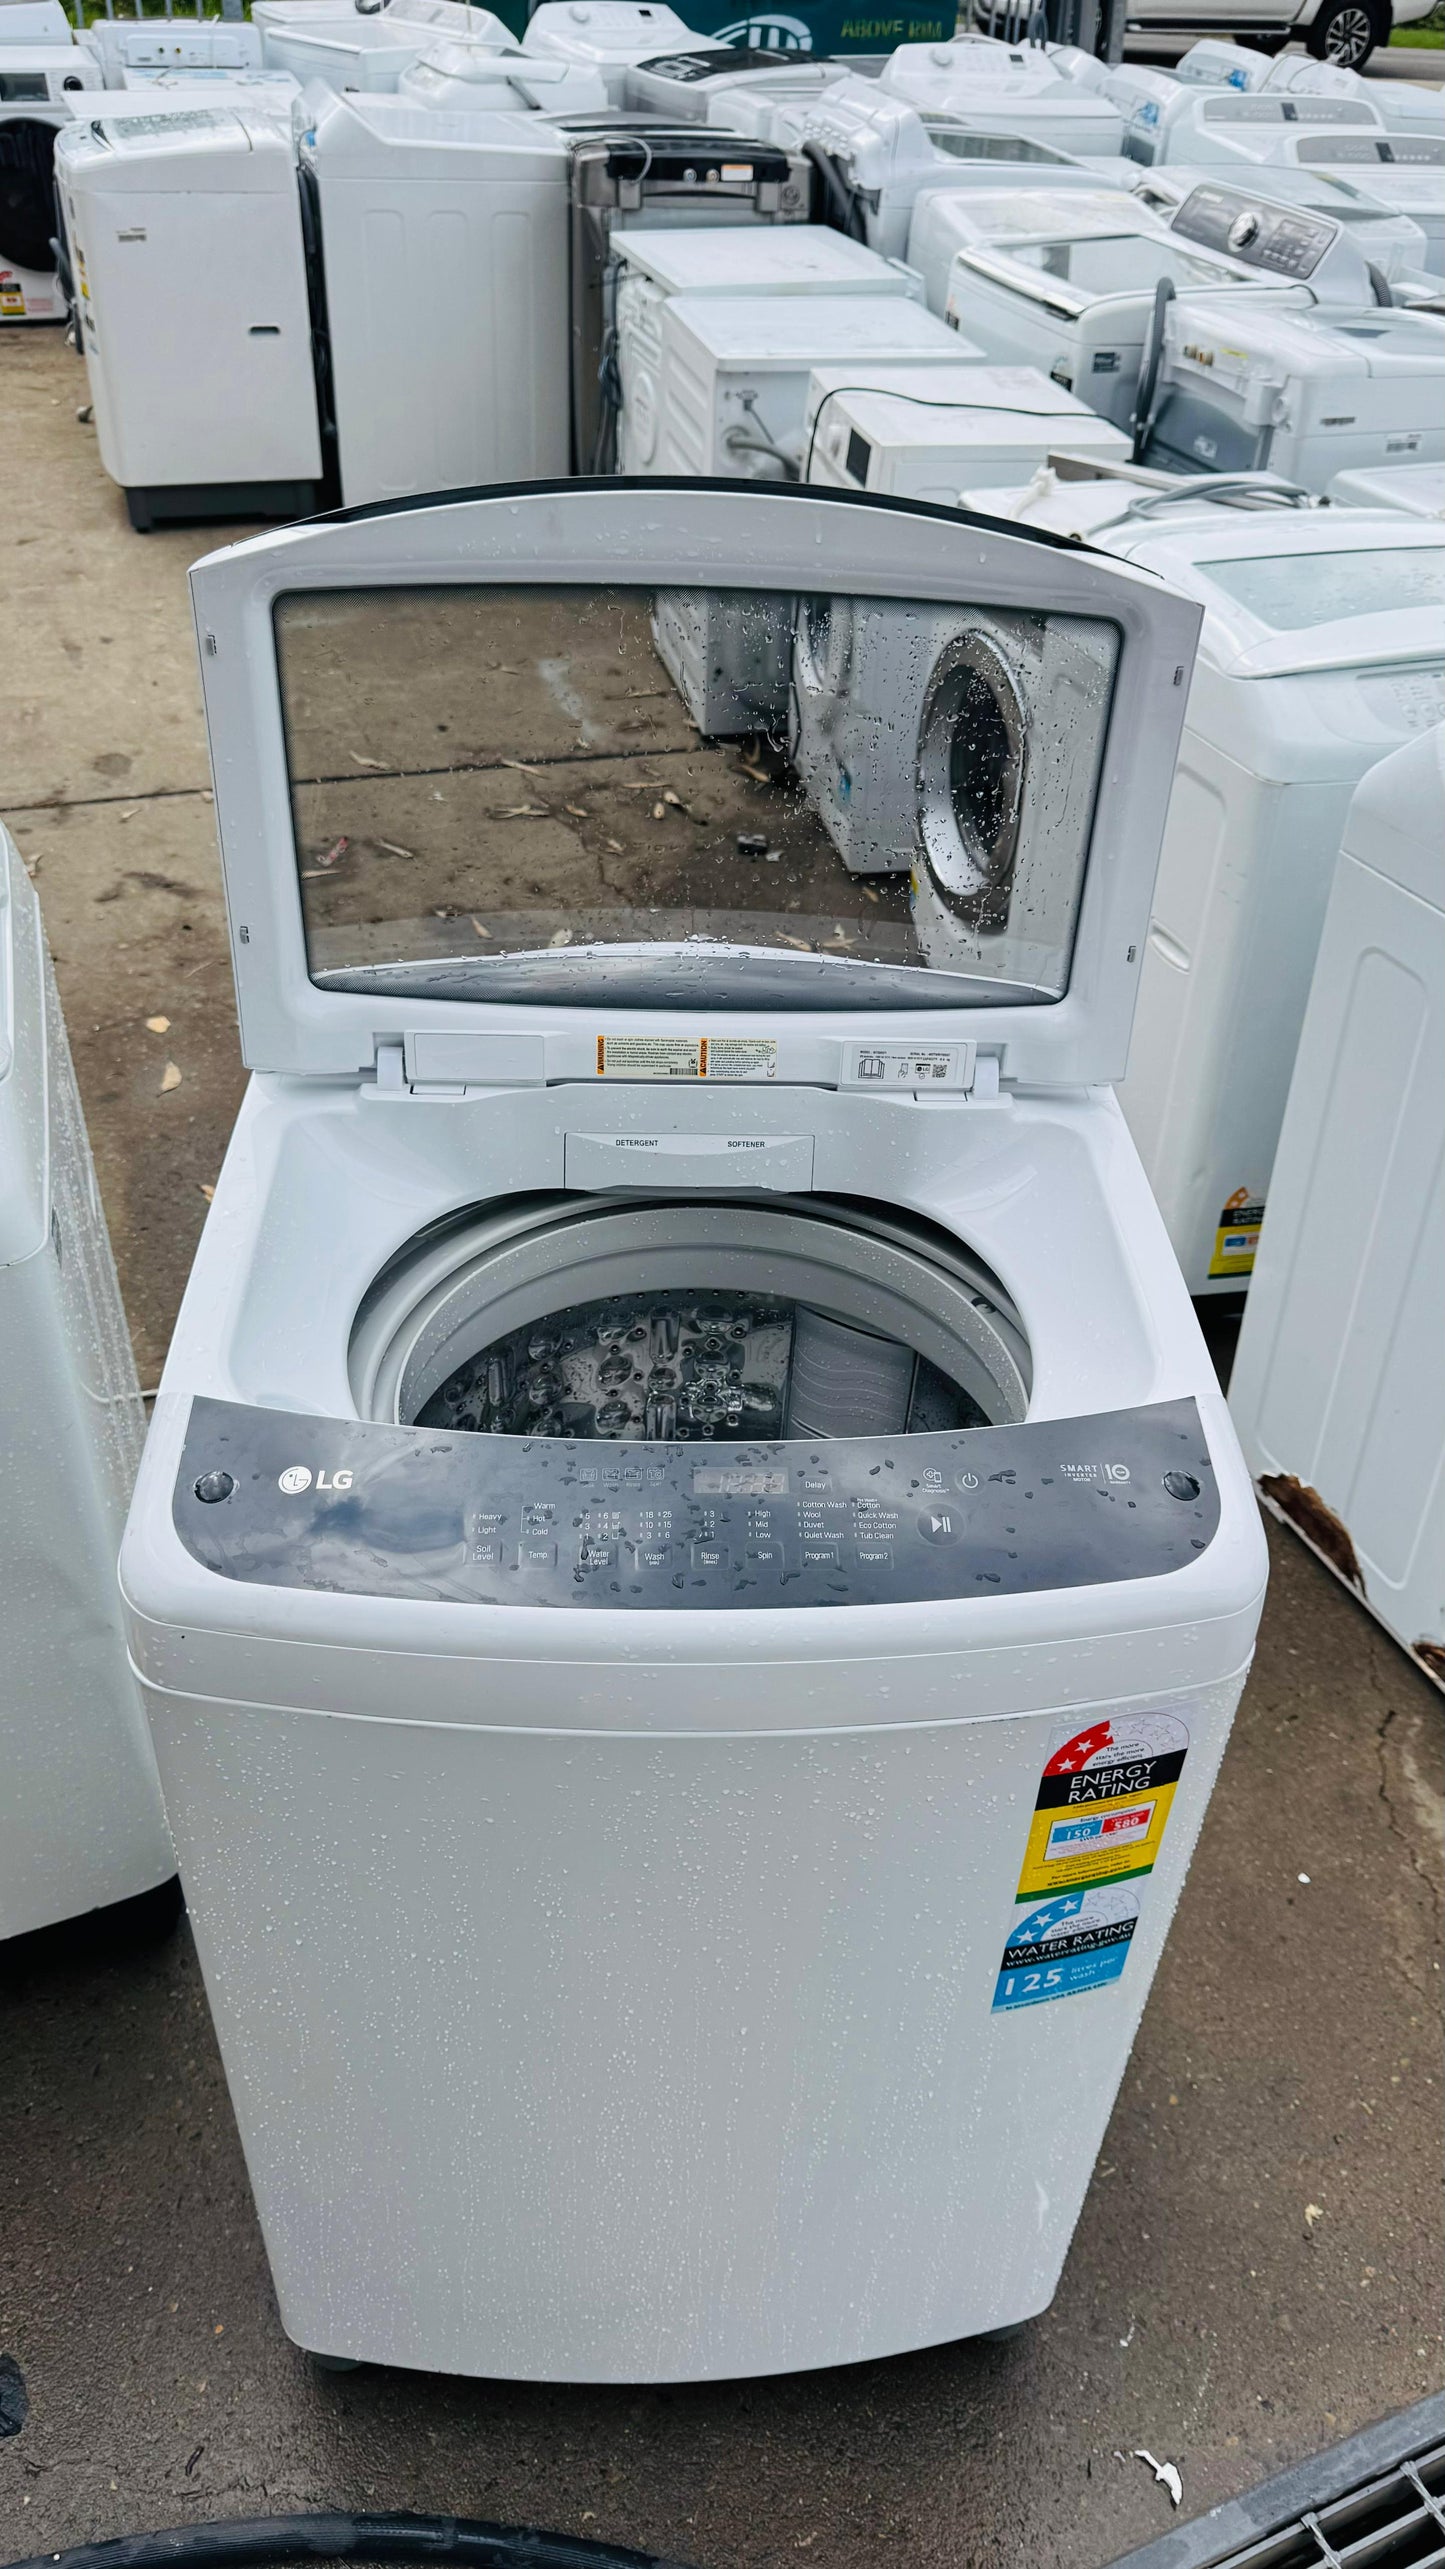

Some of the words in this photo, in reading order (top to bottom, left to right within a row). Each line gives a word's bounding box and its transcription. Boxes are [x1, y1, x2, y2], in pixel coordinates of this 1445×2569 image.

[840, 19, 904, 38] ABOVE
[615, 1139, 658, 1147] DETERGENT
[727, 1140, 765, 1148] SOFTENER
[1060, 1464, 1097, 1472] SMART
[316, 1470, 354, 1490] LG
[805, 1481, 826, 1490] Delay
[754, 1510, 771, 1518] High
[477, 1545, 491, 1553] Soil
[528, 1551, 547, 1559] Temp
[758, 1552, 772, 1560] Spin
[1070, 1761, 1157, 1789] ENERGY
[1068, 1776, 1151, 1803] RATING
[1114, 1817, 1139, 1831] 580
[1066, 1828, 1091, 1840] 150
[1008, 1940, 1068, 1959] WATER
[1073, 1921, 1134, 1946] RATING
[1070, 1970, 1095, 1981] wash
